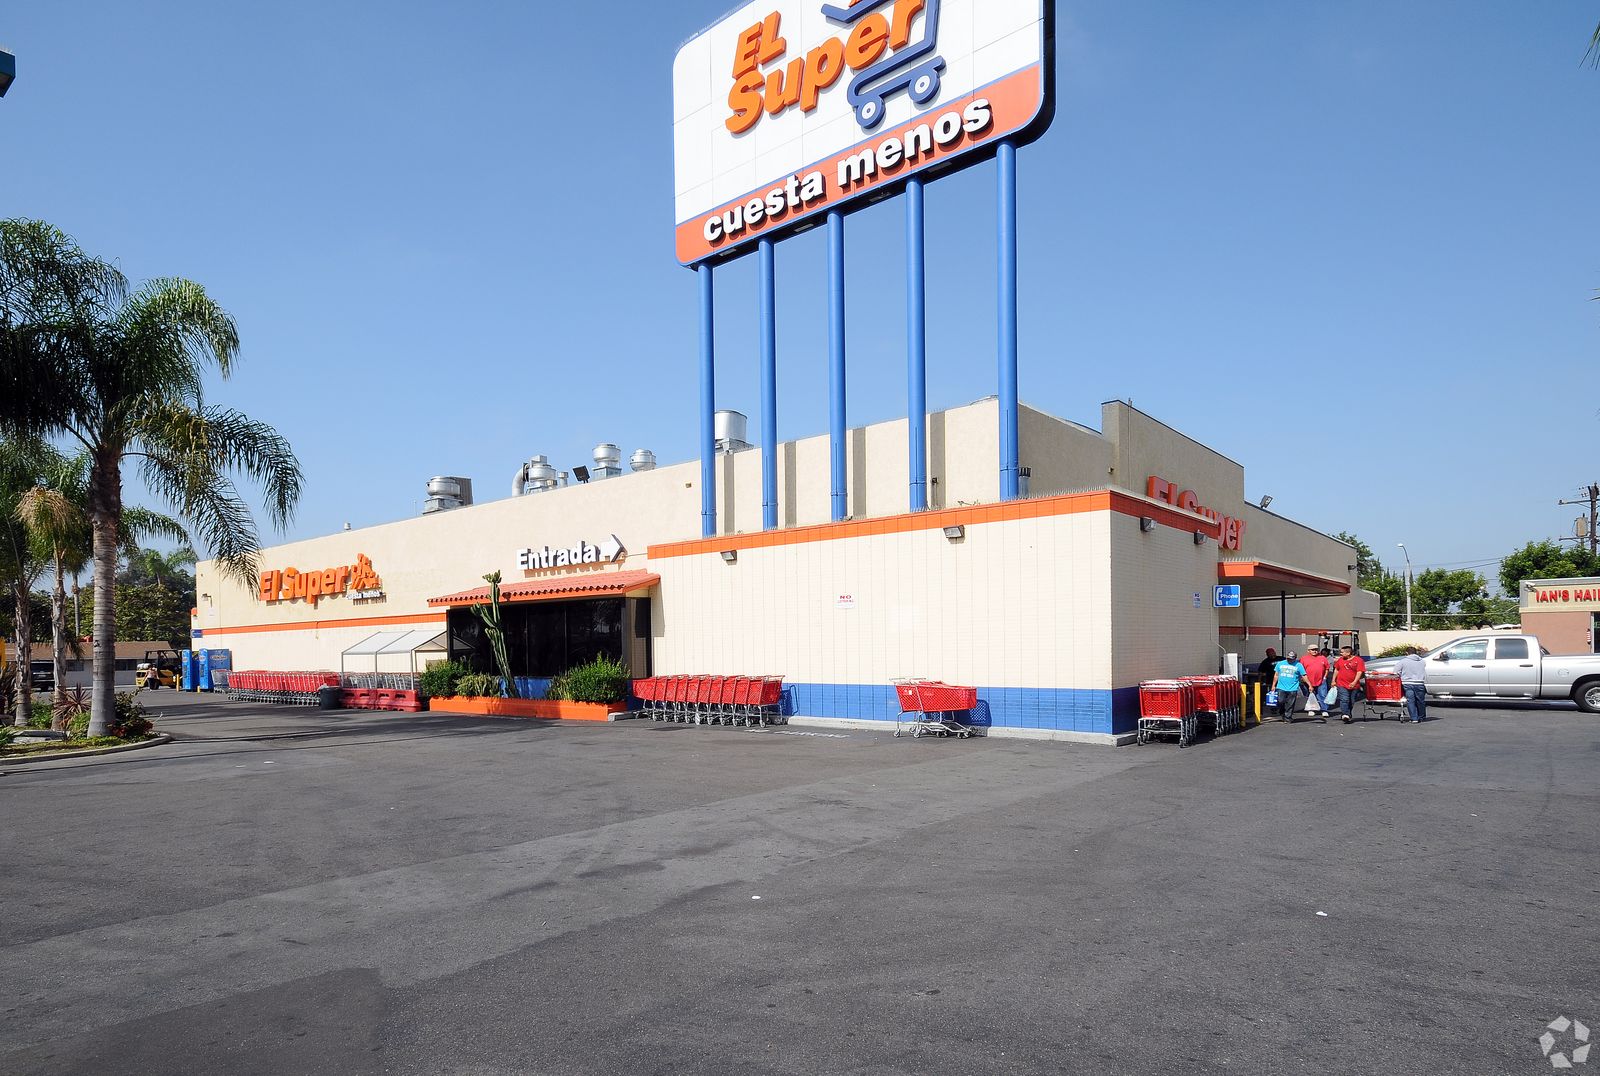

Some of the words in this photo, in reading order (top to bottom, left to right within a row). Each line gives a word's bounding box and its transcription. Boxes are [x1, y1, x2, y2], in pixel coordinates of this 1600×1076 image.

[725, 0, 925, 134] Super
[732, 10, 786, 79] EL
[703, 173, 825, 242] cuesta
[837, 98, 994, 189] menos
[1178, 489, 1247, 551] Sper
[260, 569, 281, 601] El
[281, 567, 349, 604] Super
[516, 540, 601, 571] Entrada
[1574, 588, 1600, 602] HAI
